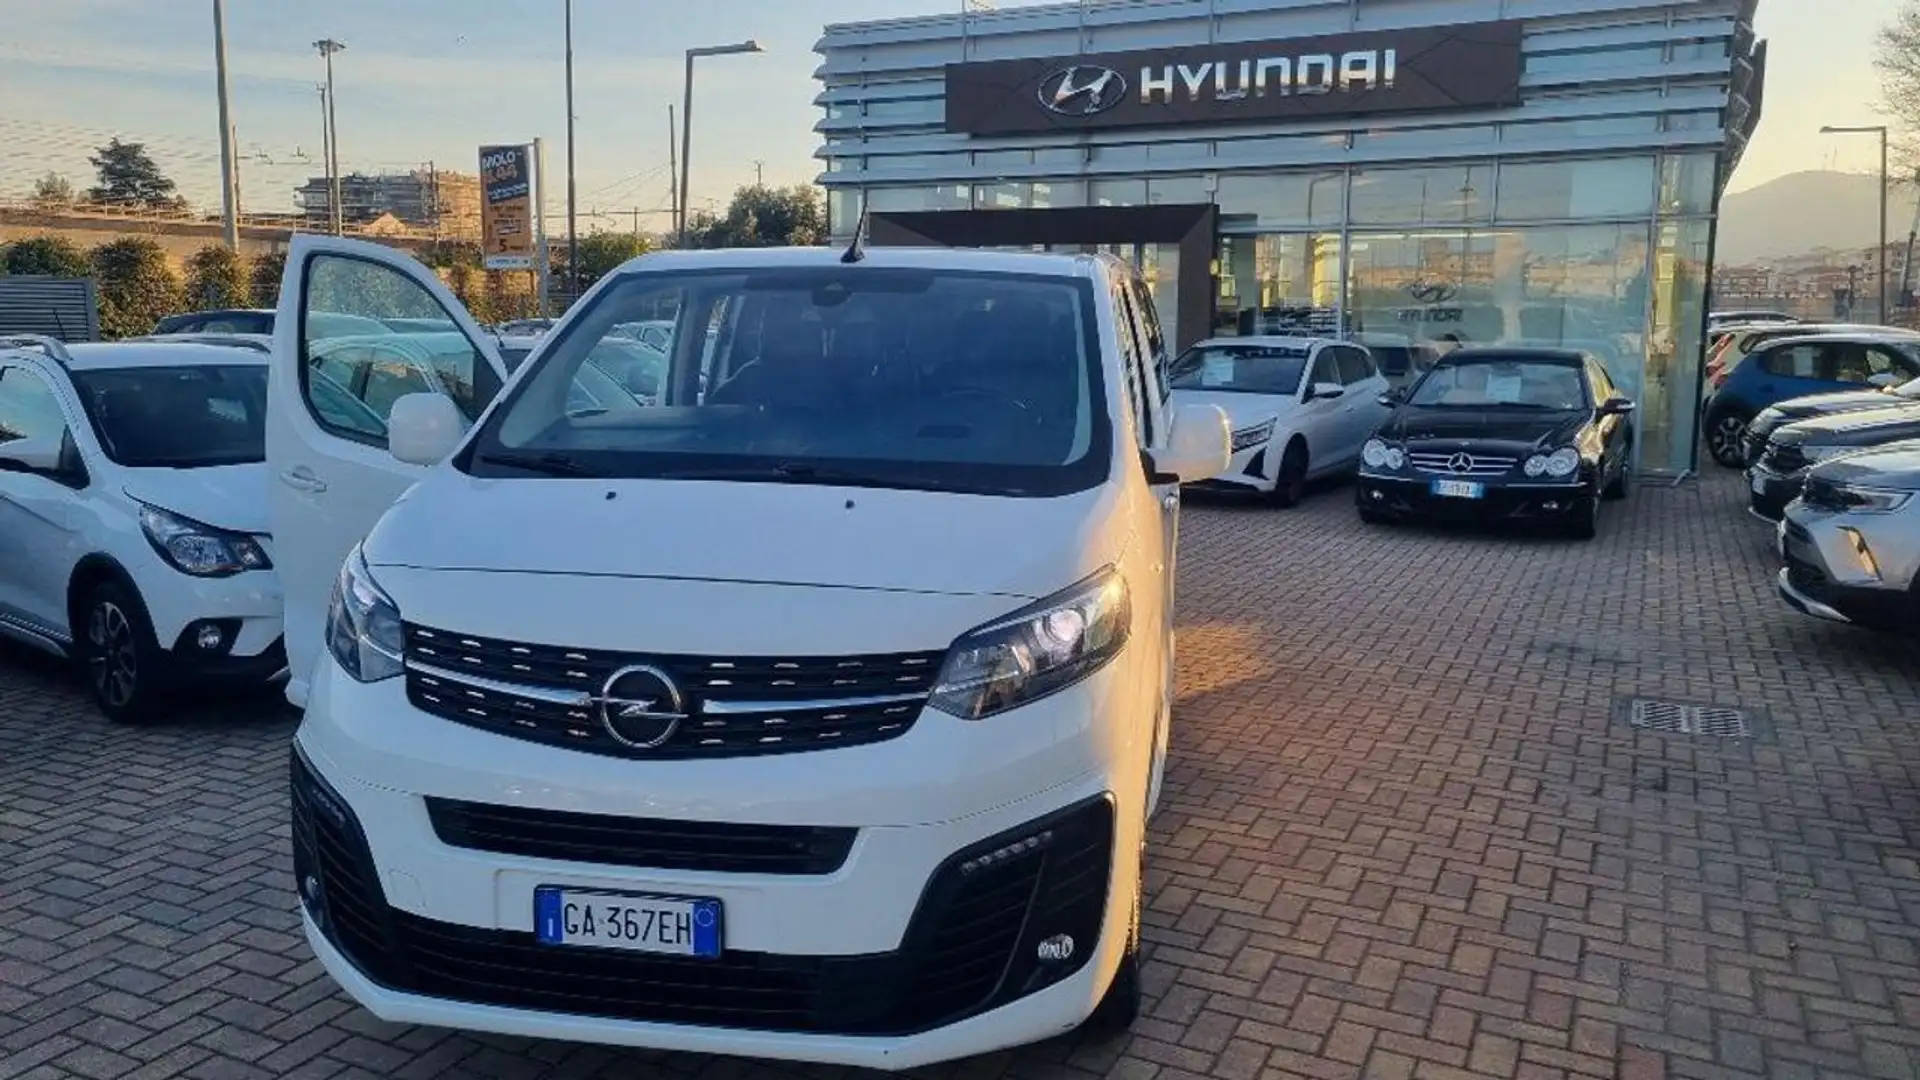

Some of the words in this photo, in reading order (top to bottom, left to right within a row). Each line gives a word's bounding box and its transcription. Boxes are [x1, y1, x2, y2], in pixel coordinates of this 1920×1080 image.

[1140, 48, 1396, 105] HYUNDAI
[564, 903, 596, 937] GA
[606, 907, 692, 945] 367EH
